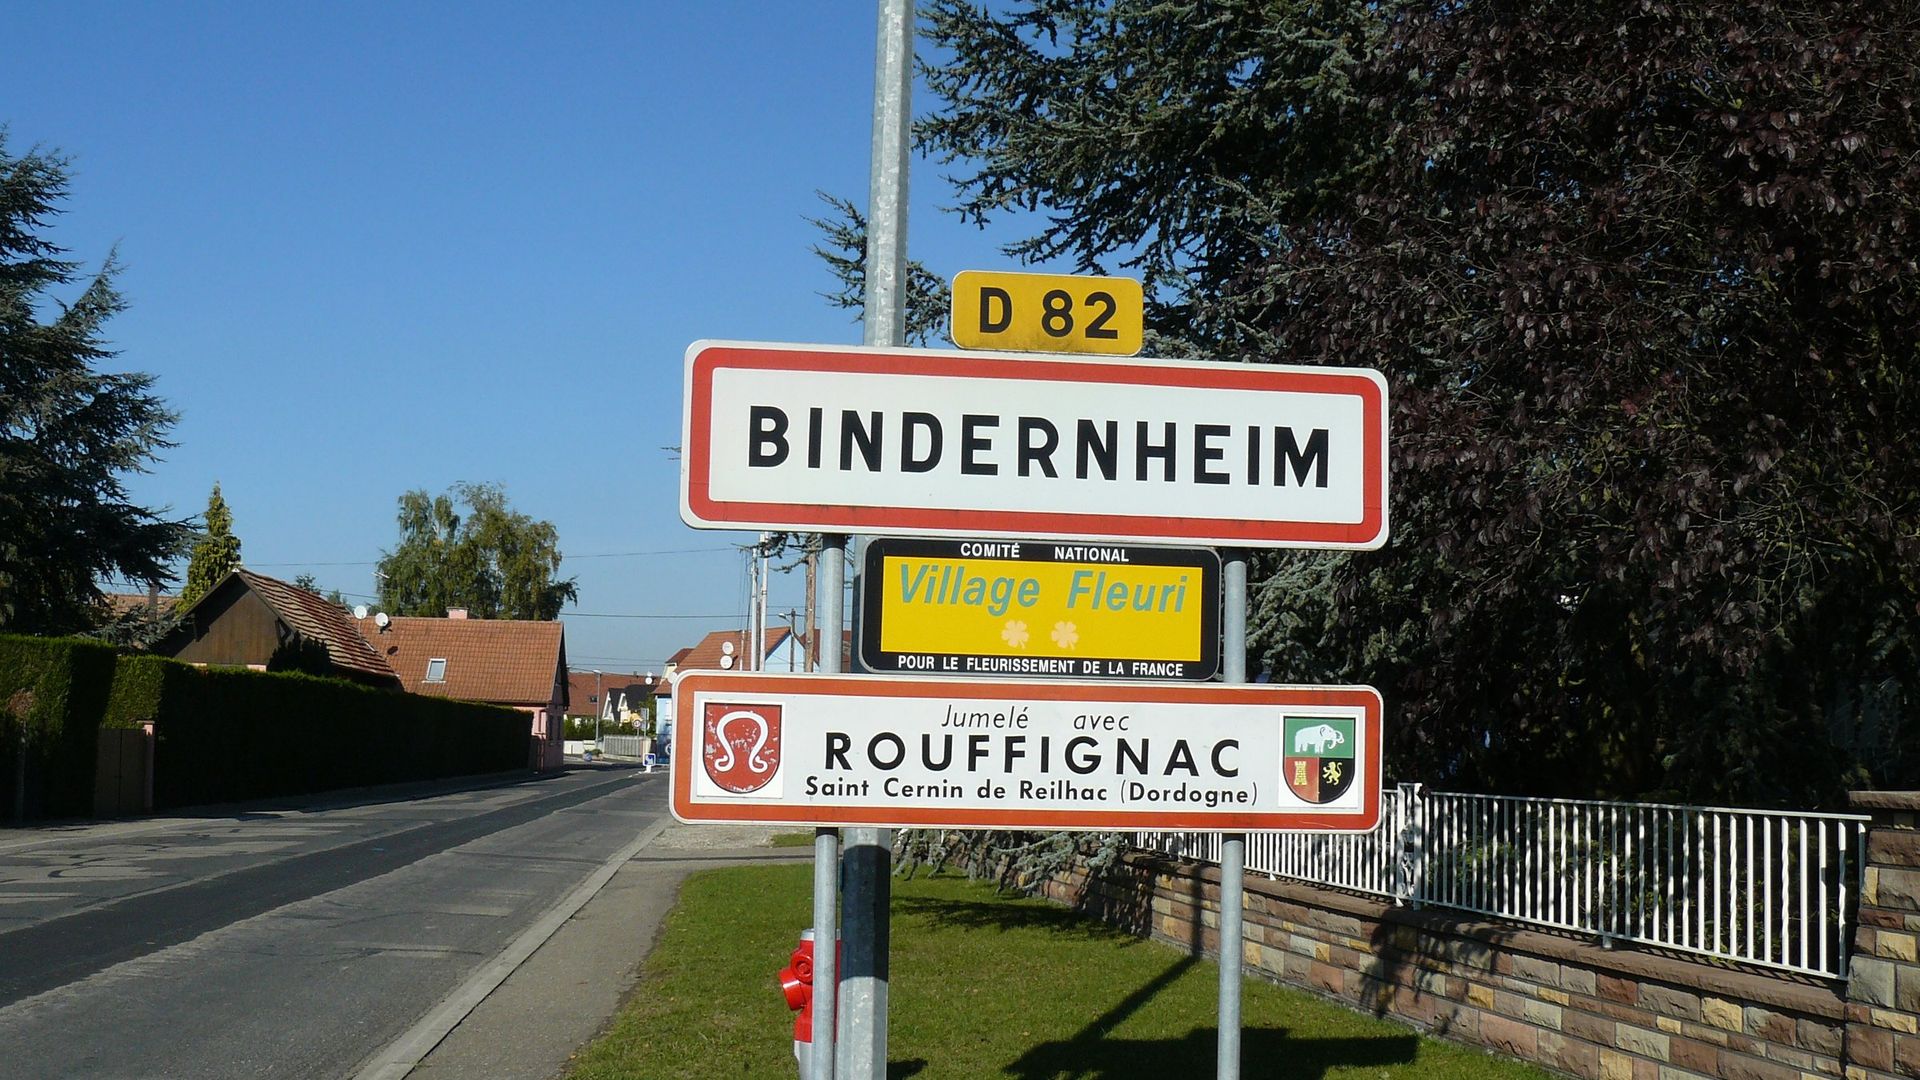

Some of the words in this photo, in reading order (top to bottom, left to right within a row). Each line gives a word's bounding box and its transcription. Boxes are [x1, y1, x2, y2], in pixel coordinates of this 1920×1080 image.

[978, 286, 1013, 332] D
[1041, 290, 1119, 339] 82
[748, 405, 1330, 488] BINDERNHEIM
[960, 542, 1021, 559] COMITÉ
[1054, 546, 1130, 563] NATIONAL
[900, 563, 1040, 616] Village
[1066, 569, 1188, 613] Fleuri
[898, 655, 935, 670] POUR
[943, 657, 959, 671] LE
[966, 658, 1075, 674] FLEURISSEMENT
[1083, 662, 1100, 675] DE
[1108, 662, 1125, 676] LA
[1132, 663, 1184, 677] FRANCE
[941, 704, 1029, 729] Jumelé
[1073, 714, 1130, 731] avec
[825, 732, 1240, 778] ROUFFIGNAC
[805, 775, 869, 797] Saint
[883, 776, 964, 799] Cernin
[977, 778, 1006, 800] de
[1019, 779, 1108, 801] Reilhac
[1120, 780, 1259, 807] (Dordogne)
